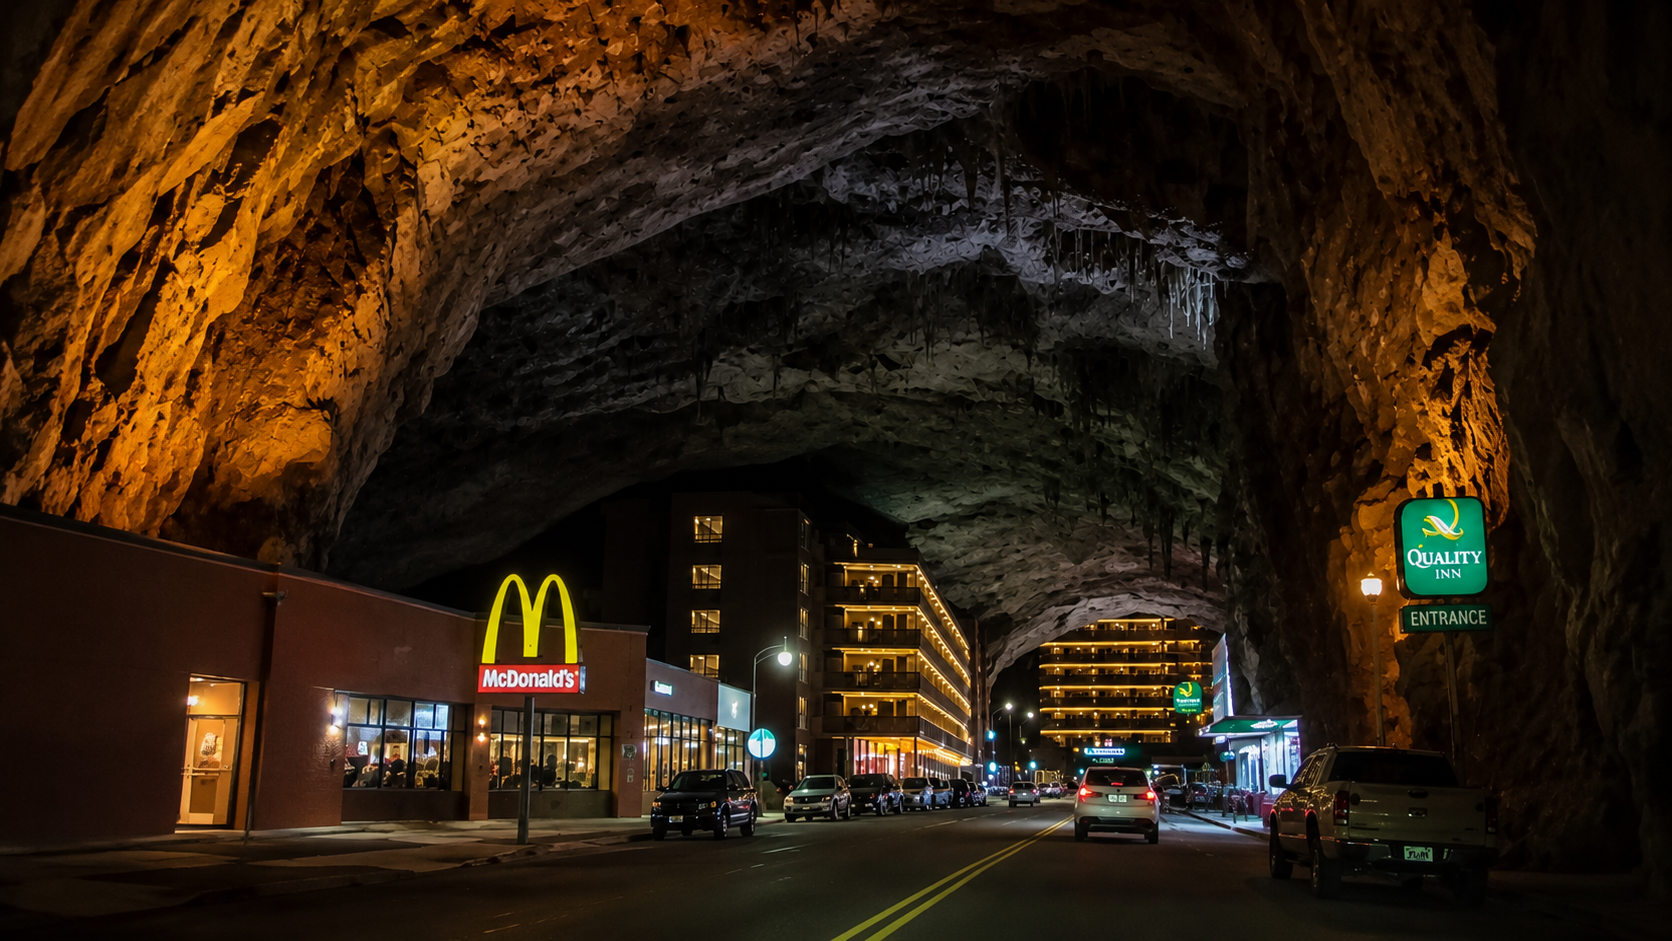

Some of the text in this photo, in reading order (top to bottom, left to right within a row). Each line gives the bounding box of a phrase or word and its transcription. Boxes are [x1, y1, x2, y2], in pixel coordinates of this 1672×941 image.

[1407, 549, 1482, 568] QUALITY
[1435, 569, 1462, 579] INN
[1411, 610, 1487, 626] ENTRANCE
[482, 669, 575, 688] McDonald's
